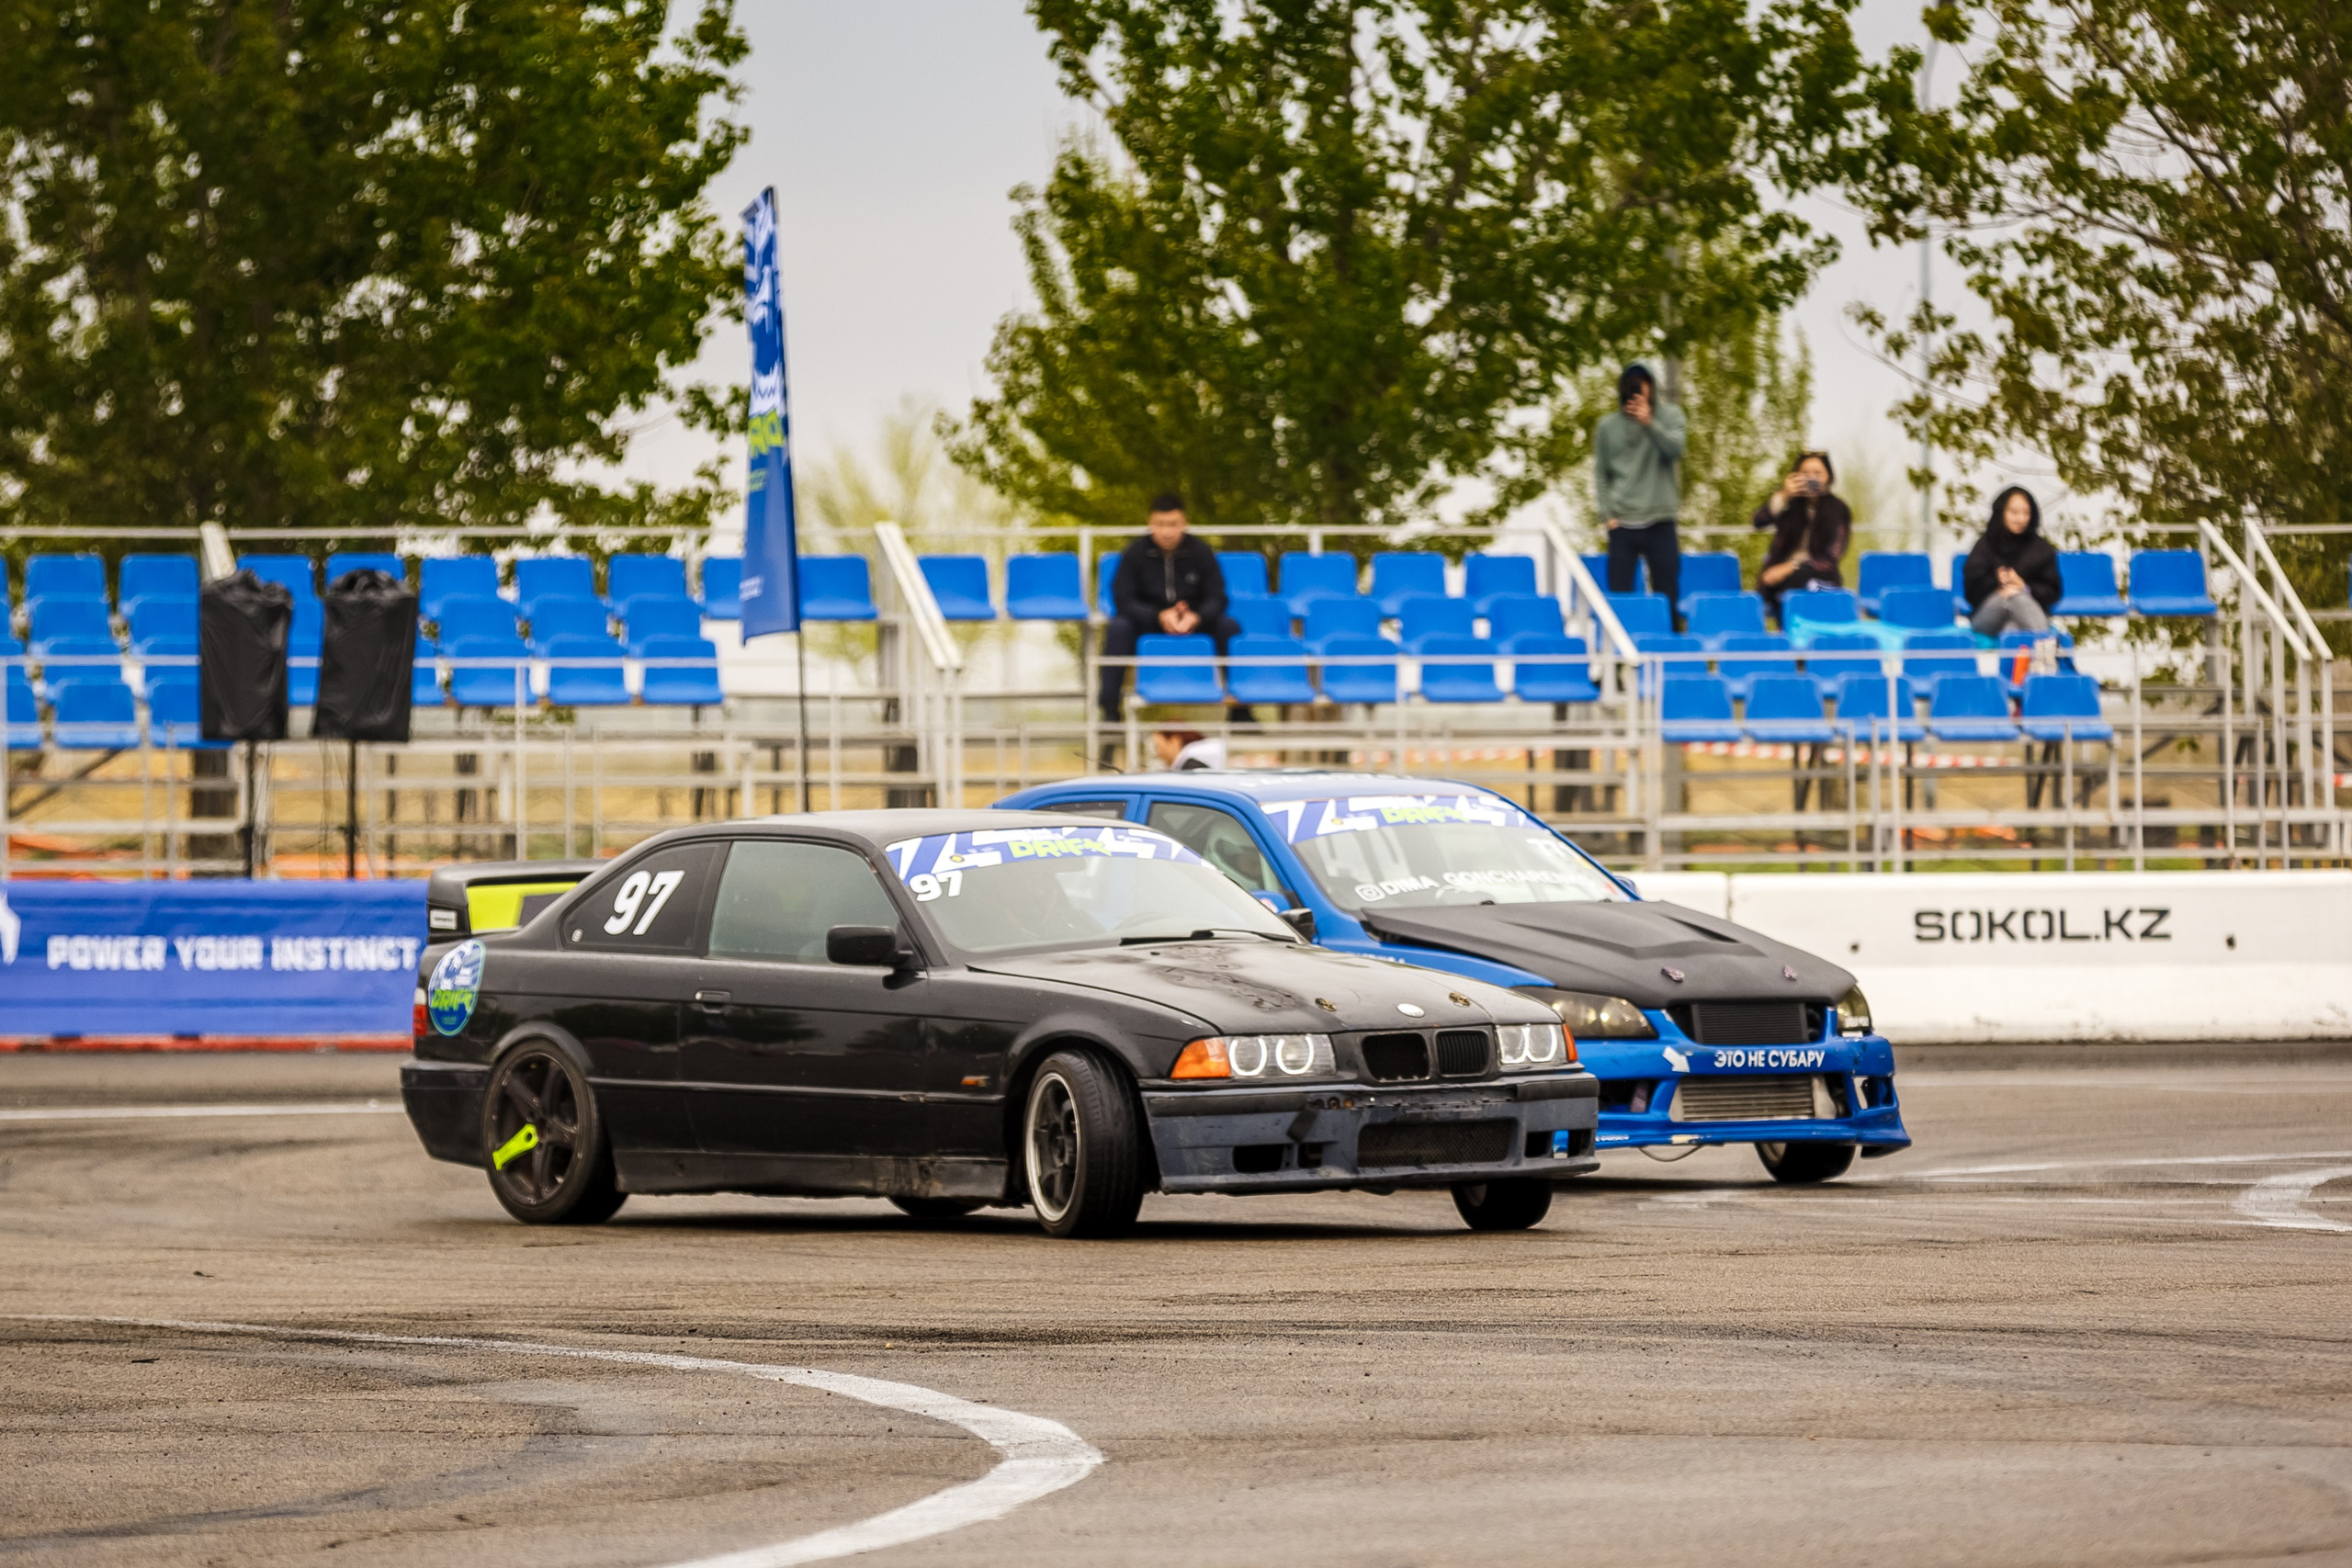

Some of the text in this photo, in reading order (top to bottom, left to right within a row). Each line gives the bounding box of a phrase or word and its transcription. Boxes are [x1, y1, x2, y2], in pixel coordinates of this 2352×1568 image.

[603, 869, 685, 935] 97
[909, 870, 963, 902] 97
[1914, 908, 2172, 942] SOKOL.KZ
[47, 935, 422, 971] POWER YOUR INSTINCT
[1713, 1049, 1826, 1067] ЭТО НЕ СУБАРУ
